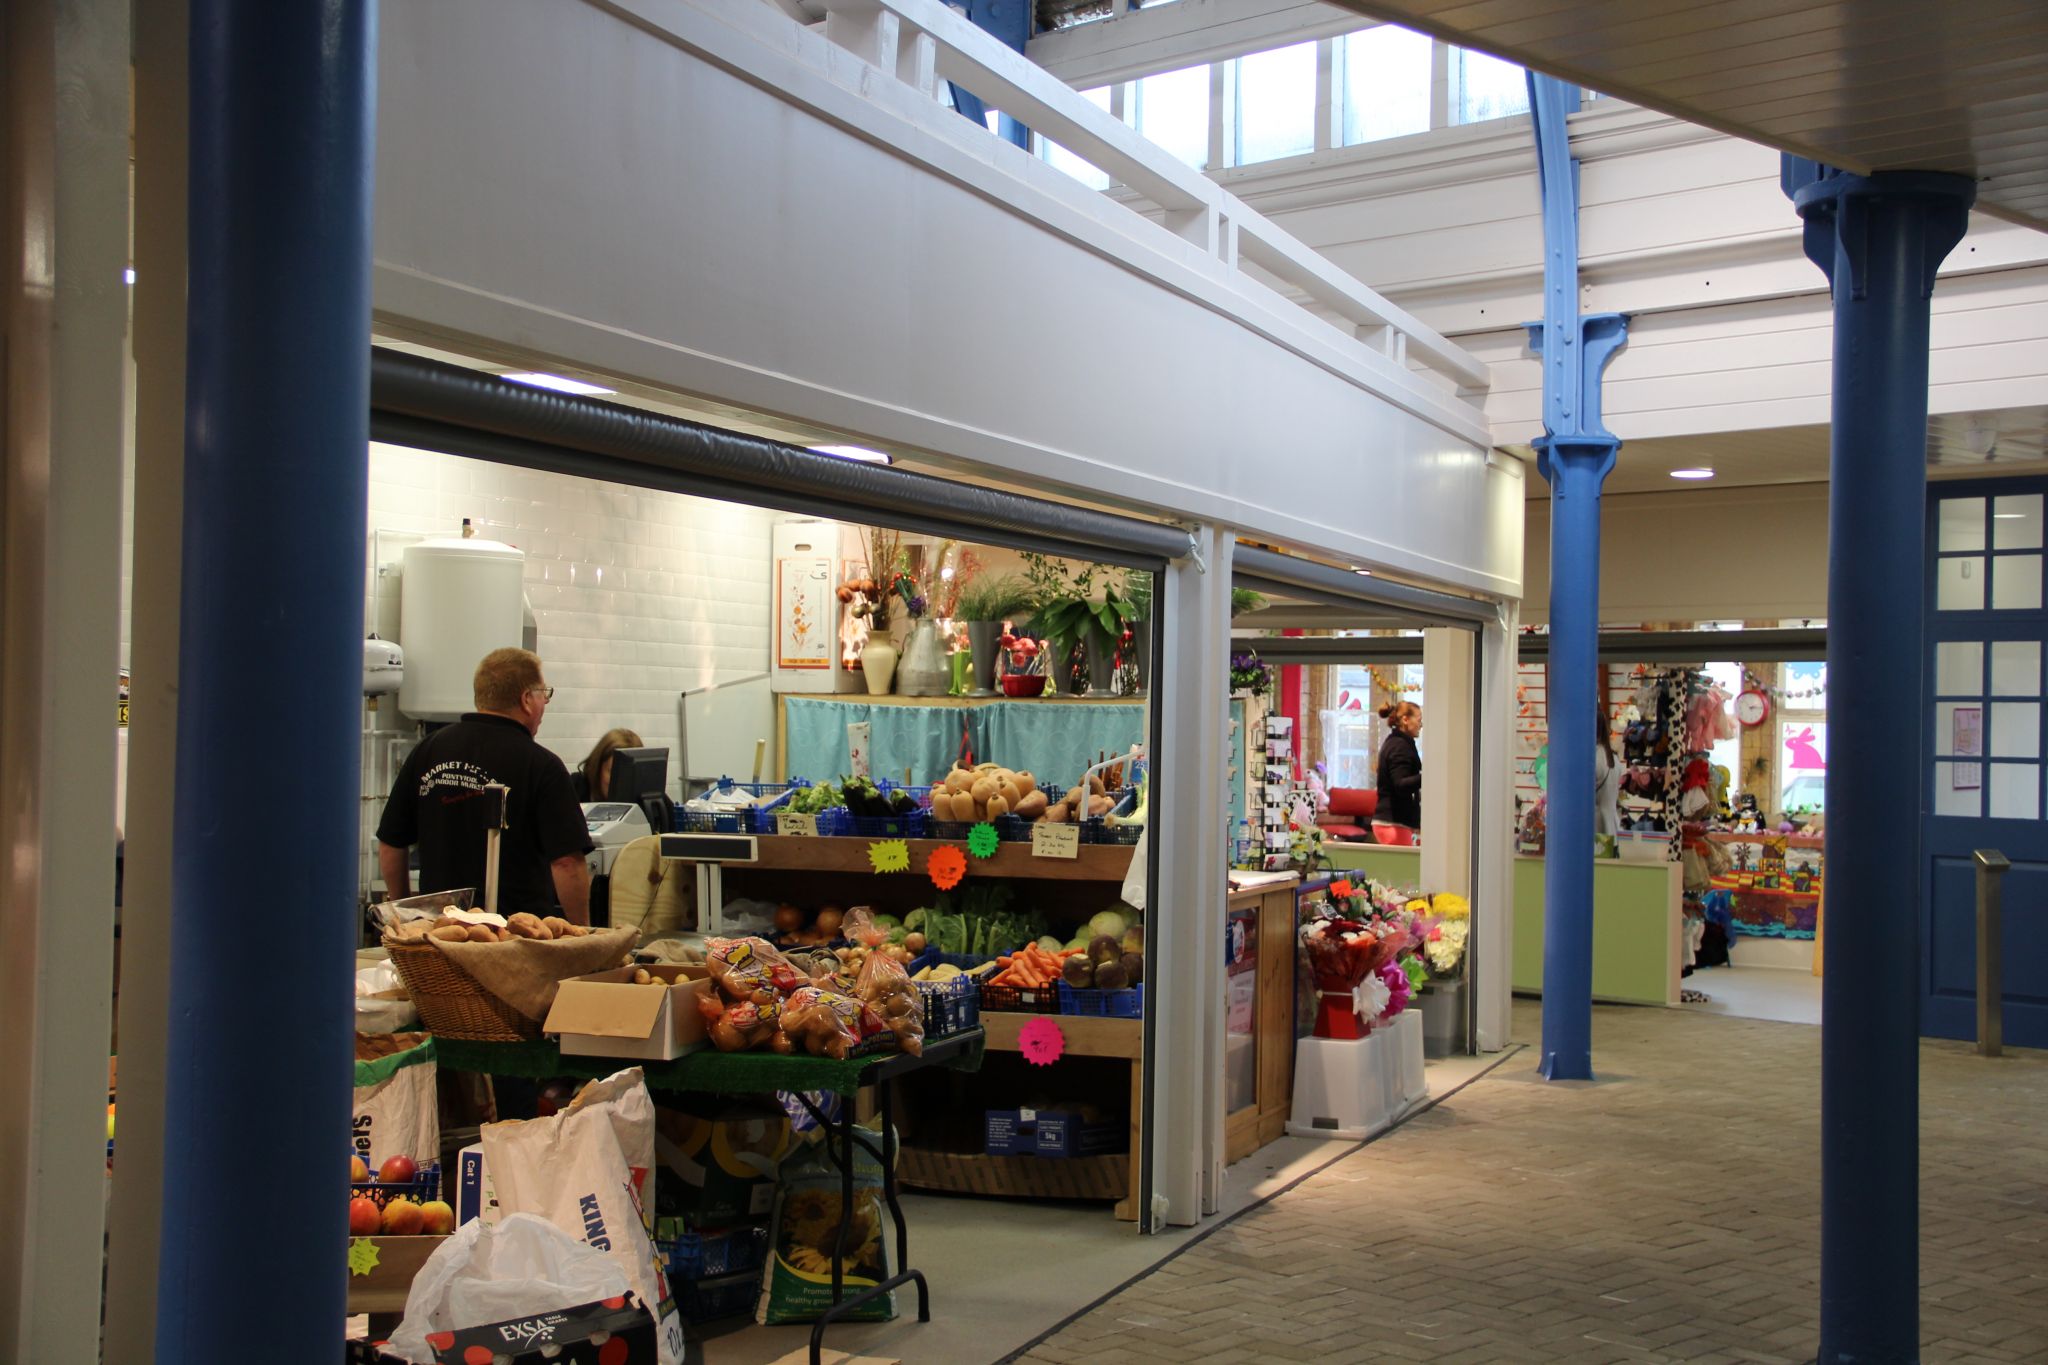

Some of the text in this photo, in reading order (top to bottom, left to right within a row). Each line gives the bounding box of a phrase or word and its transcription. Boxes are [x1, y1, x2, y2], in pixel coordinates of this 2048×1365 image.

[421, 761, 462, 783] MARKET
[466, 1160, 476, 1177] Cat
[580, 1192, 611, 1252] KING
[803, 1287, 833, 1295] Promote
[499, 1319, 547, 1342] EXSA
